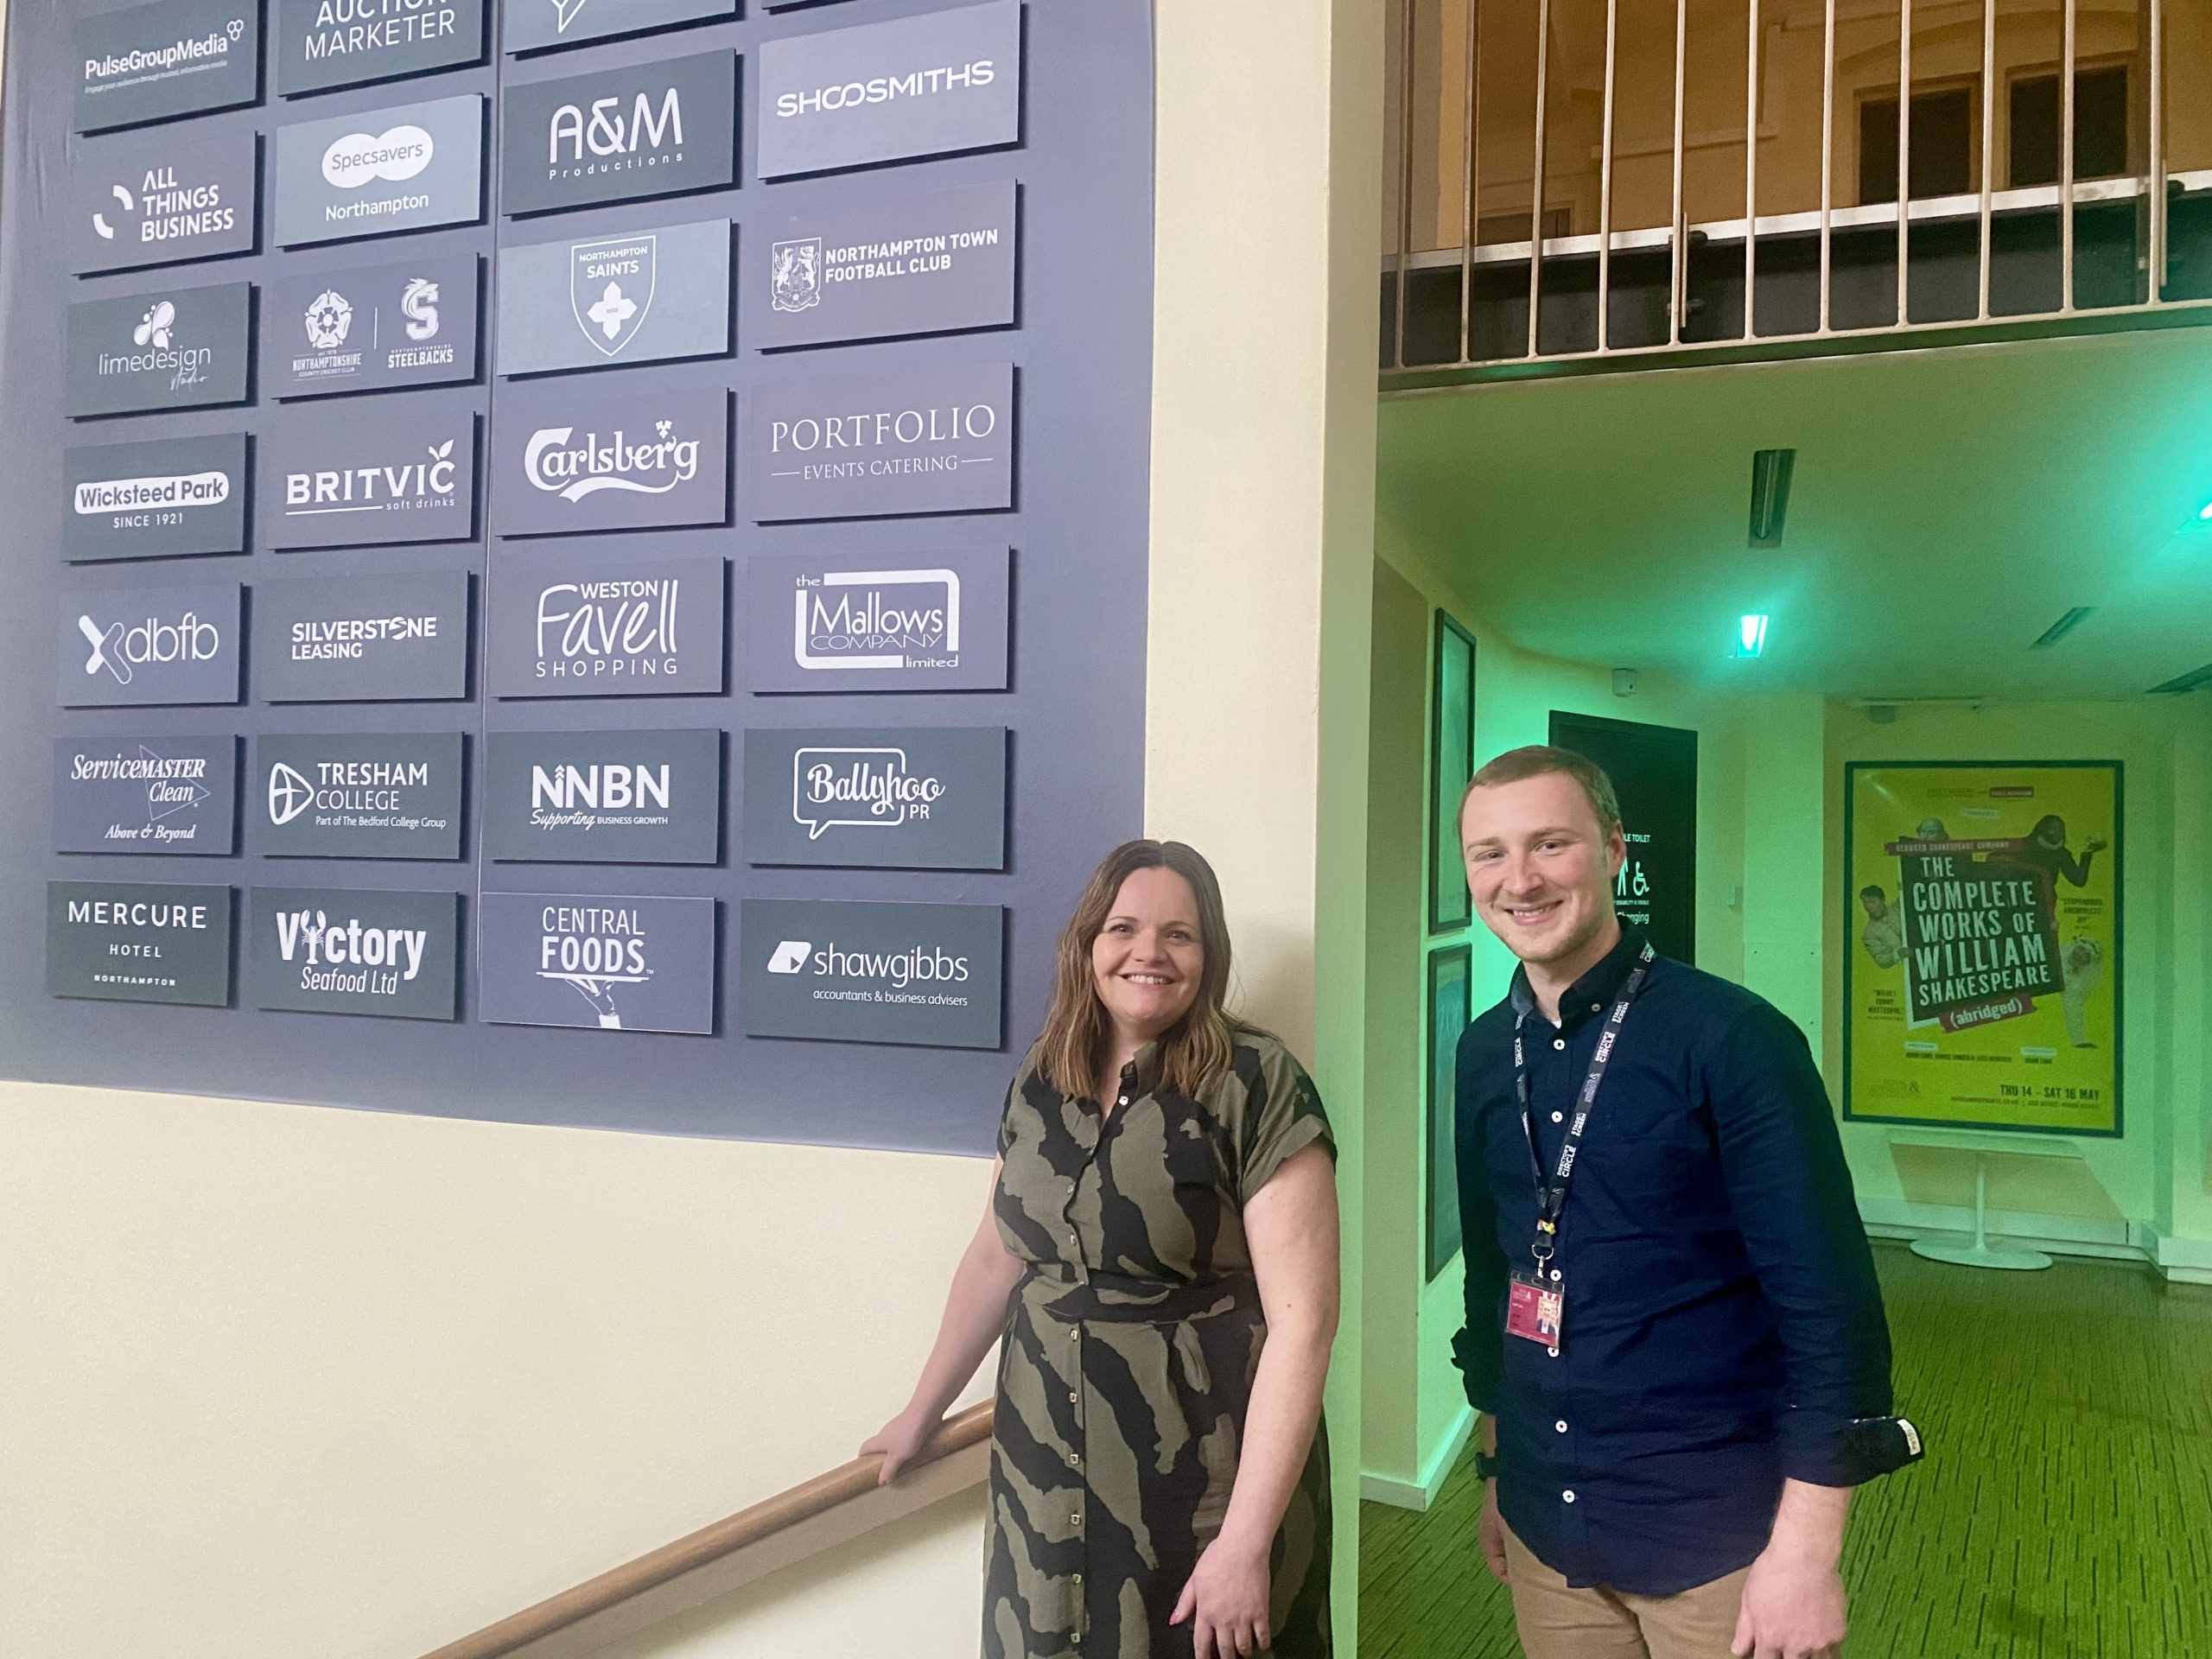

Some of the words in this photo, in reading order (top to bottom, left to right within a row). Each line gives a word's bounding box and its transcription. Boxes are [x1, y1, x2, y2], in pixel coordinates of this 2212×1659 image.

[305, 9, 454, 60] MARKETER
[85, 33, 228, 79] PulseGroupMedia
[777, 60, 995, 118] SHOOSMITHS
[550, 87, 683, 163] A&M
[332, 141, 423, 172] Specsavers
[550, 152, 683, 181] Productions
[142, 167, 177, 193] ALL
[143, 185, 219, 217] THINGS
[326, 193, 429, 221] Northampton
[142, 208, 233, 242] BUSINESS
[579, 245, 648, 263] NORTHAMPTON
[825, 235, 945, 264] NORTHAMPTON
[949, 229, 998, 250] TOWN
[587, 260, 639, 278] SAINTS
[825, 260, 906, 283] FOOTBALL
[910, 254, 951, 273] CLUB
[99, 346, 212, 375] limedesign
[292, 353, 362, 372] NORTHAMPTONSHIRE
[388, 348, 454, 369] STEELBACKS
[299, 369, 320, 378] COUNTY
[320, 367, 340, 376] CRICKET
[771, 404, 996, 453] PORTFOLIO
[524, 425, 700, 493] Carlsberg
[804, 461, 864, 480] EVENTS
[869, 454, 958, 476] CATERING
[79, 480, 175, 508] Wicksteed
[181, 478, 224, 500] Park
[286, 461, 455, 505] BRITVIC
[386, 499, 411, 511] soft
[416, 497, 455, 510] drinks
[113, 514, 149, 529] SINCE
[156, 512, 183, 525] 1921
[580, 581, 658, 601] WESTON
[796, 575, 821, 588] the
[537, 580, 678, 658] Favell
[810, 592, 944, 637] Mallows
[124, 612, 219, 663] dbfb
[292, 616, 437, 642] SILVERSTONE
[810, 633, 944, 652] COMPANY
[292, 642, 362, 660] LEASING
[906, 655, 959, 668] limited
[536, 658, 677, 677] SHOPPING
[71, 753, 207, 779] ServiceMASTER
[318, 763, 429, 786] TRESHAM
[149, 780, 194, 803] Clean
[316, 790, 399, 810] COLLEGE
[806, 763, 946, 816] Ballyhoo
[315, 816, 333, 826] Part
[334, 816, 342, 826] of
[343, 816, 358, 827] The
[358, 816, 389, 828] Bedford
[391, 817, 419, 830] College
[421, 817, 447, 830] Group
[530, 809, 595, 831] Supporting
[597, 817, 632, 825] BUSINESS
[633, 817, 668, 825] GROWTH
[910, 804, 931, 820] PR
[105, 825, 138, 839] Above
[140, 823, 152, 839] &
[154, 824, 195, 843] Beyond
[1632, 834, 1650, 842] TOILET
[1896, 843, 1927, 853] REDUCED
[1929, 842, 1974, 852] SHAKESPEARE
[1977, 841, 2010, 849] COMPANY
[1921, 856, 1955, 878] THE
[1913, 881, 2036, 912] COMPLETE
[67, 900, 207, 929] MERCURE
[543, 906, 645, 935] CENTRAL
[1617, 911, 1649, 925] nging
[1918, 909, 2002, 944] WORKS
[2013, 912, 2036, 933] OF
[109, 944, 162, 958] HOTEL
[542, 937, 645, 974] FOODS
[1916, 933, 2047, 982] WILLIAM
[813, 943, 969, 988] shawgibbs
[93, 974, 175, 987] NORTHAMPTON
[301, 966, 366, 994] Seafood
[371, 969, 398, 995] Ltd
[1918, 964, 2051, 1007] SHAKESPEARE
[813, 989, 873, 1002] accountants
[874, 991, 883, 1002] &
[885, 991, 925, 1005] business
[927, 994, 969, 1007] advisers
[1950, 998, 2024, 1028] (abridged)
[1599, 1032, 1616, 1063] CIRCLE
[1999, 1084, 2018, 1096] THU
[2022, 1085, 2031, 1097] 14
[2044, 1086, 2061, 1098] SAT
[2064, 1087, 2075, 1099] 16
[2079, 1088, 2099, 1101] MAY
[1575, 1113, 1587, 1137] SCREEN
[1557, 1144, 1570, 1176] DIRECTOR'S
[1561, 1146, 1577, 1178] CIRCLE
